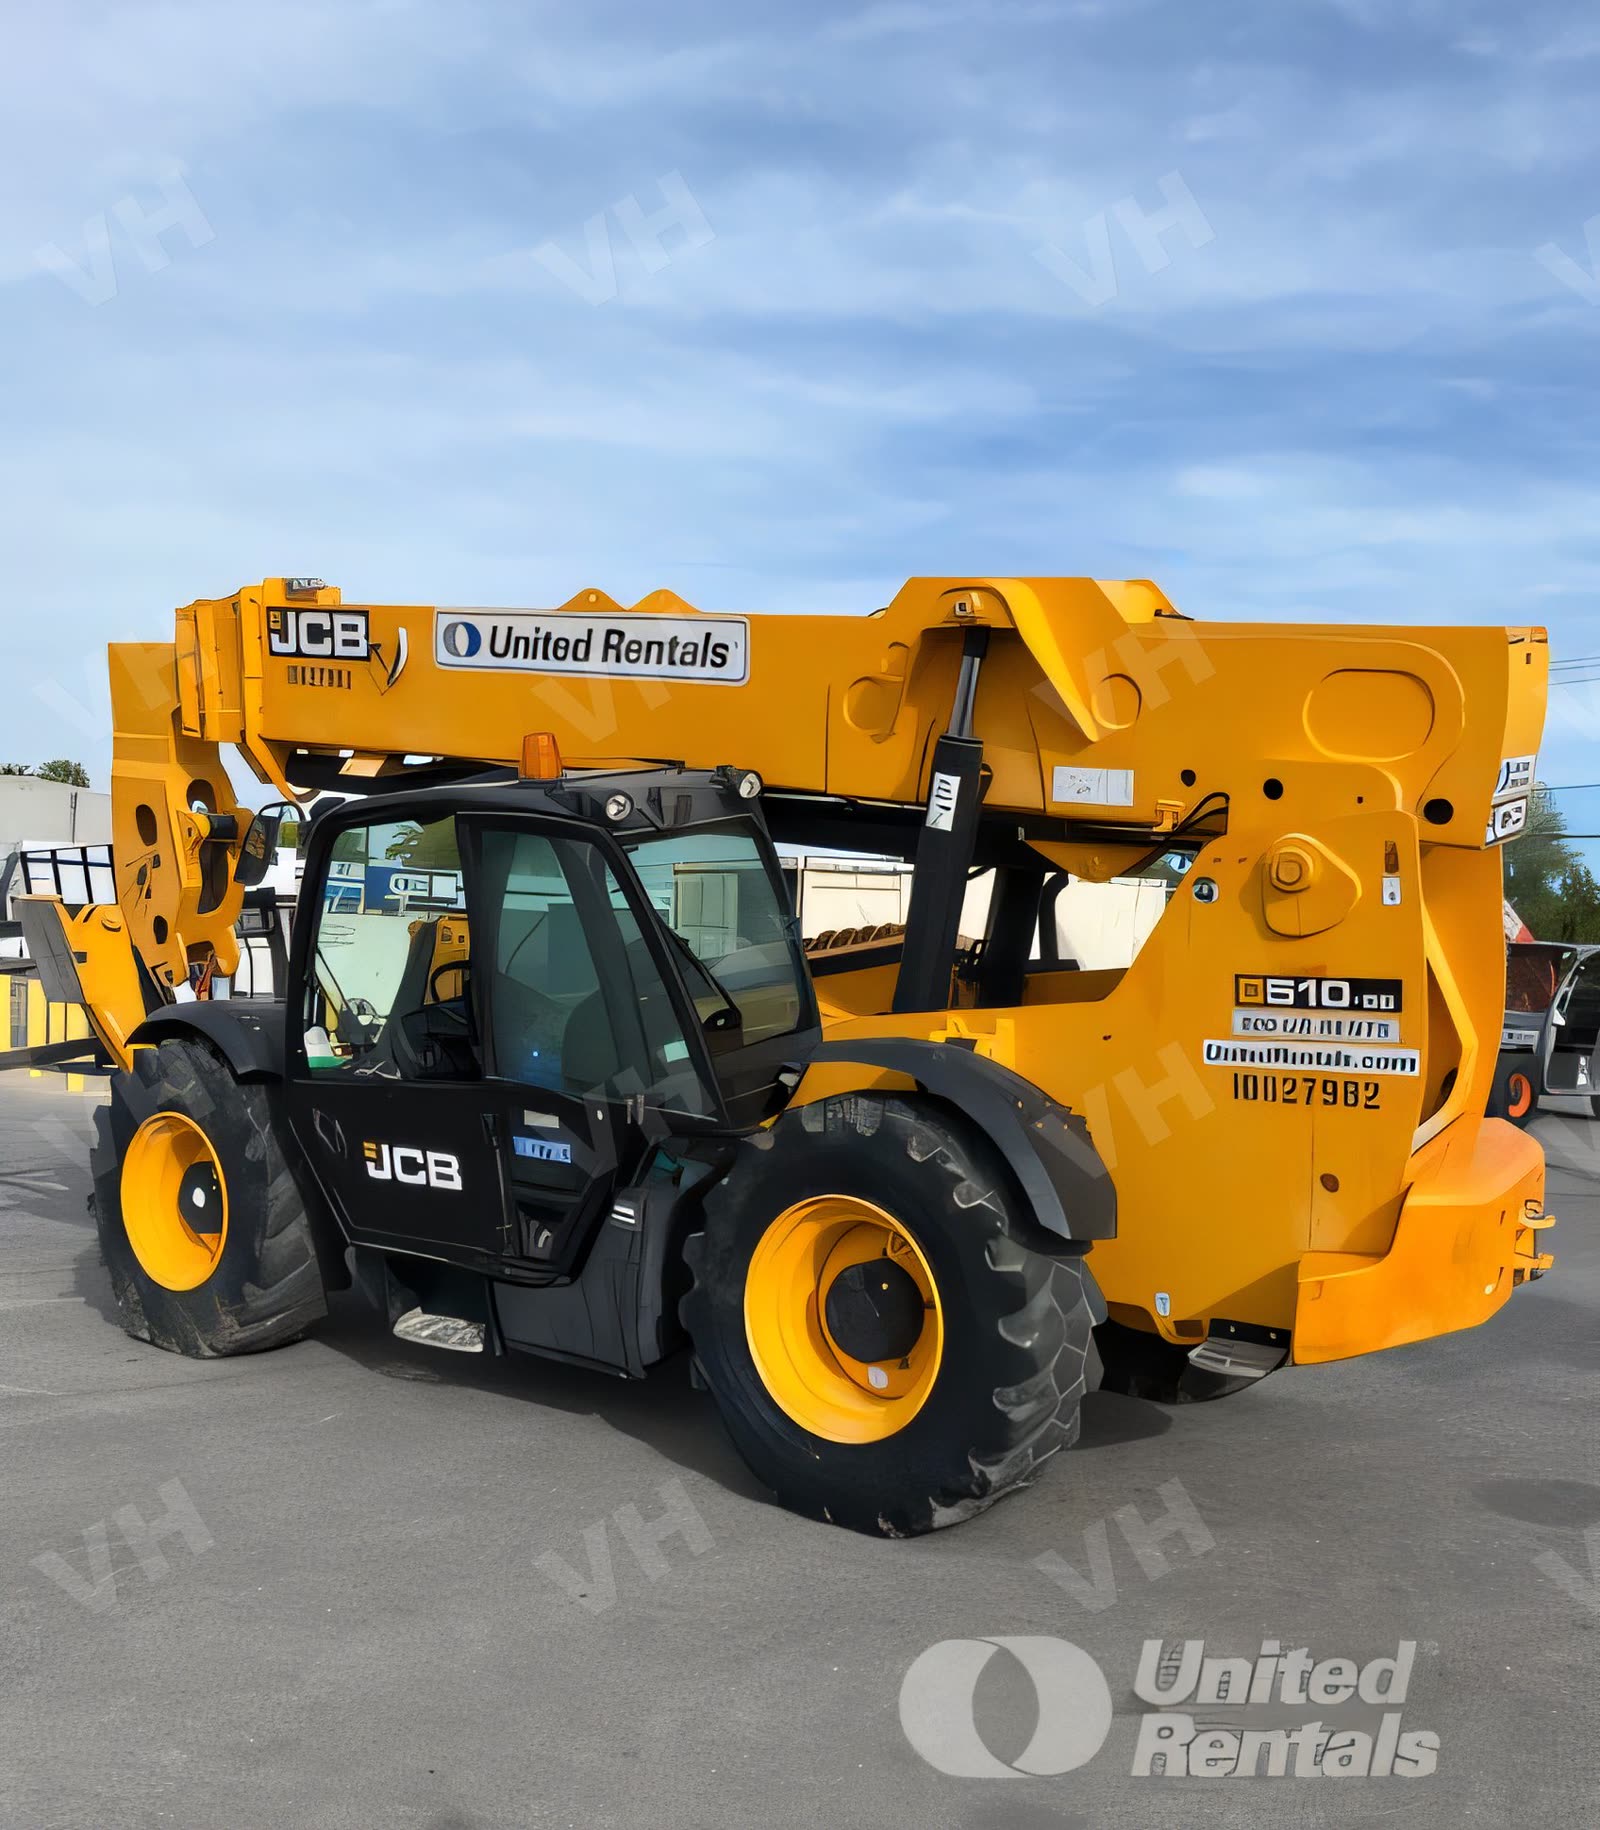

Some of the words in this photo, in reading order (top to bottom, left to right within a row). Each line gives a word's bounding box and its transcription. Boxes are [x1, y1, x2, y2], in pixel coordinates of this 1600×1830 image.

[269, 610, 368, 657] JCB
[489, 625, 593, 663] United
[601, 628, 730, 668] Rentals
[363, 1141, 462, 1190] JCB
